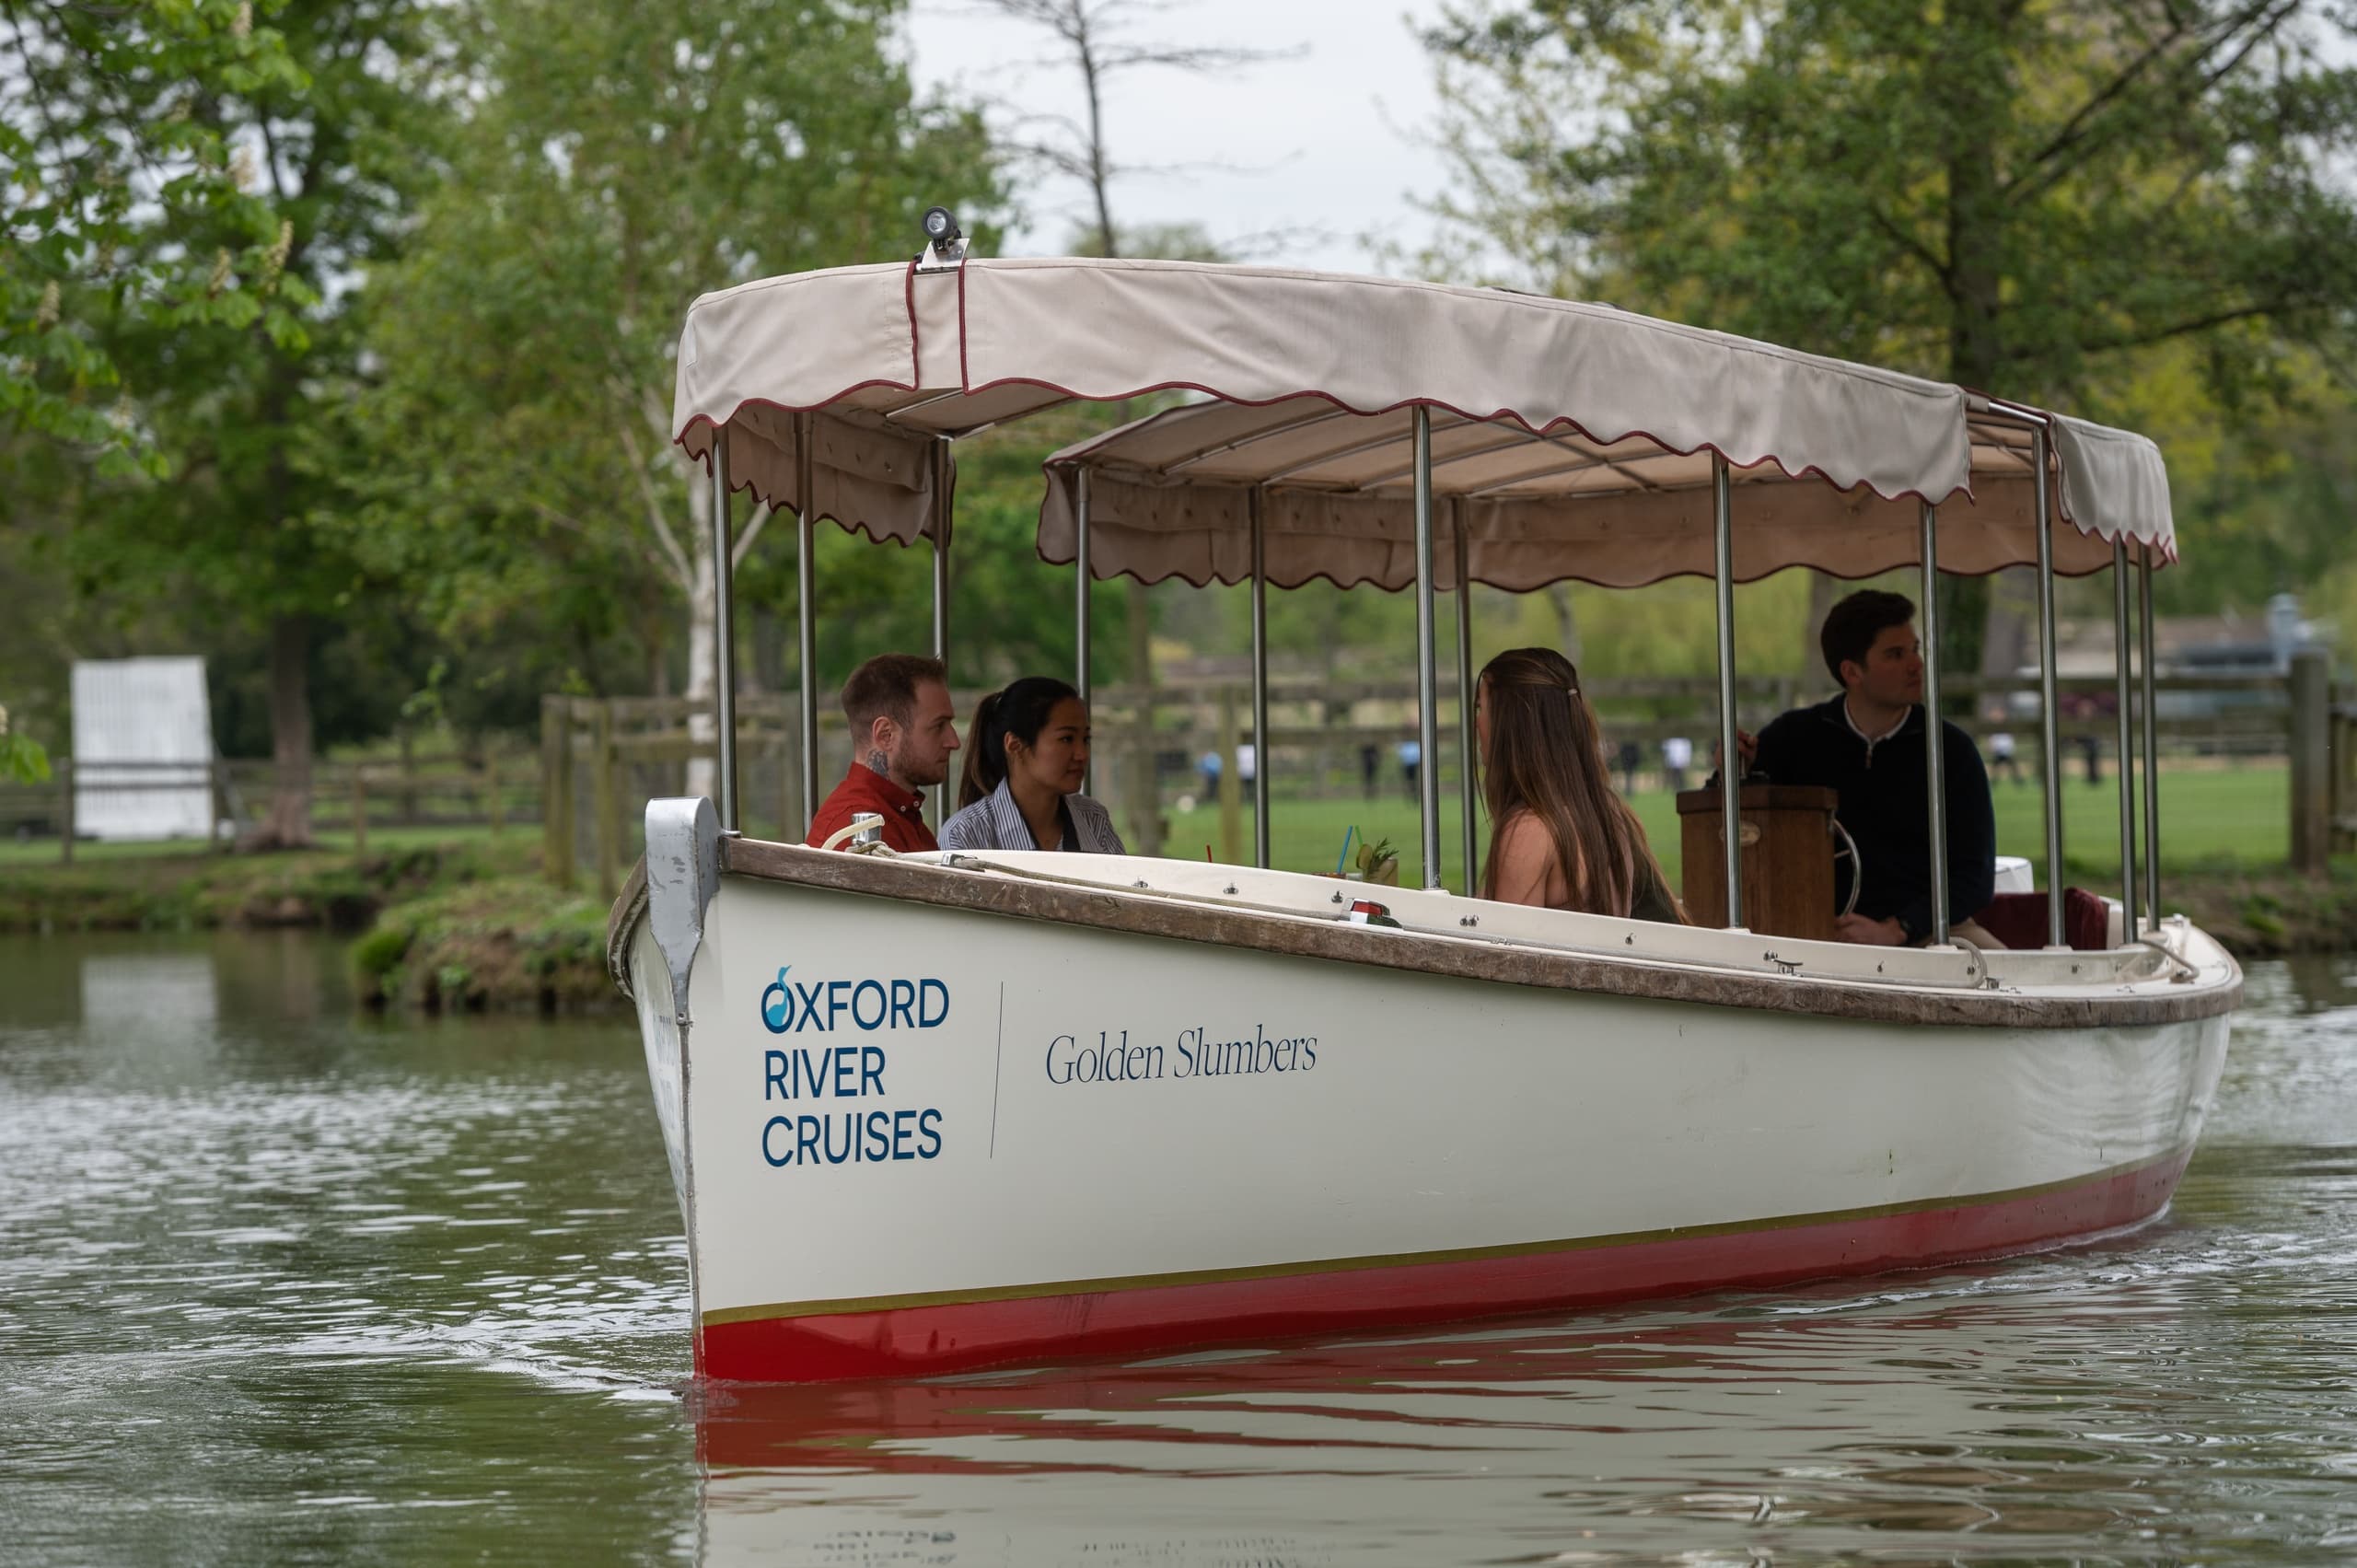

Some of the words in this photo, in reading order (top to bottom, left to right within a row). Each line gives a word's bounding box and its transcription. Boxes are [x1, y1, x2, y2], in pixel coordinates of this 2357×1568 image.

[761, 978, 950, 1035] OXFORD
[765, 1046, 886, 1101] RIVER
[1046, 1029, 1165, 1085] Golden
[1173, 1023, 1318, 1078] Slumbers
[761, 1108, 944, 1168] CRUISES
